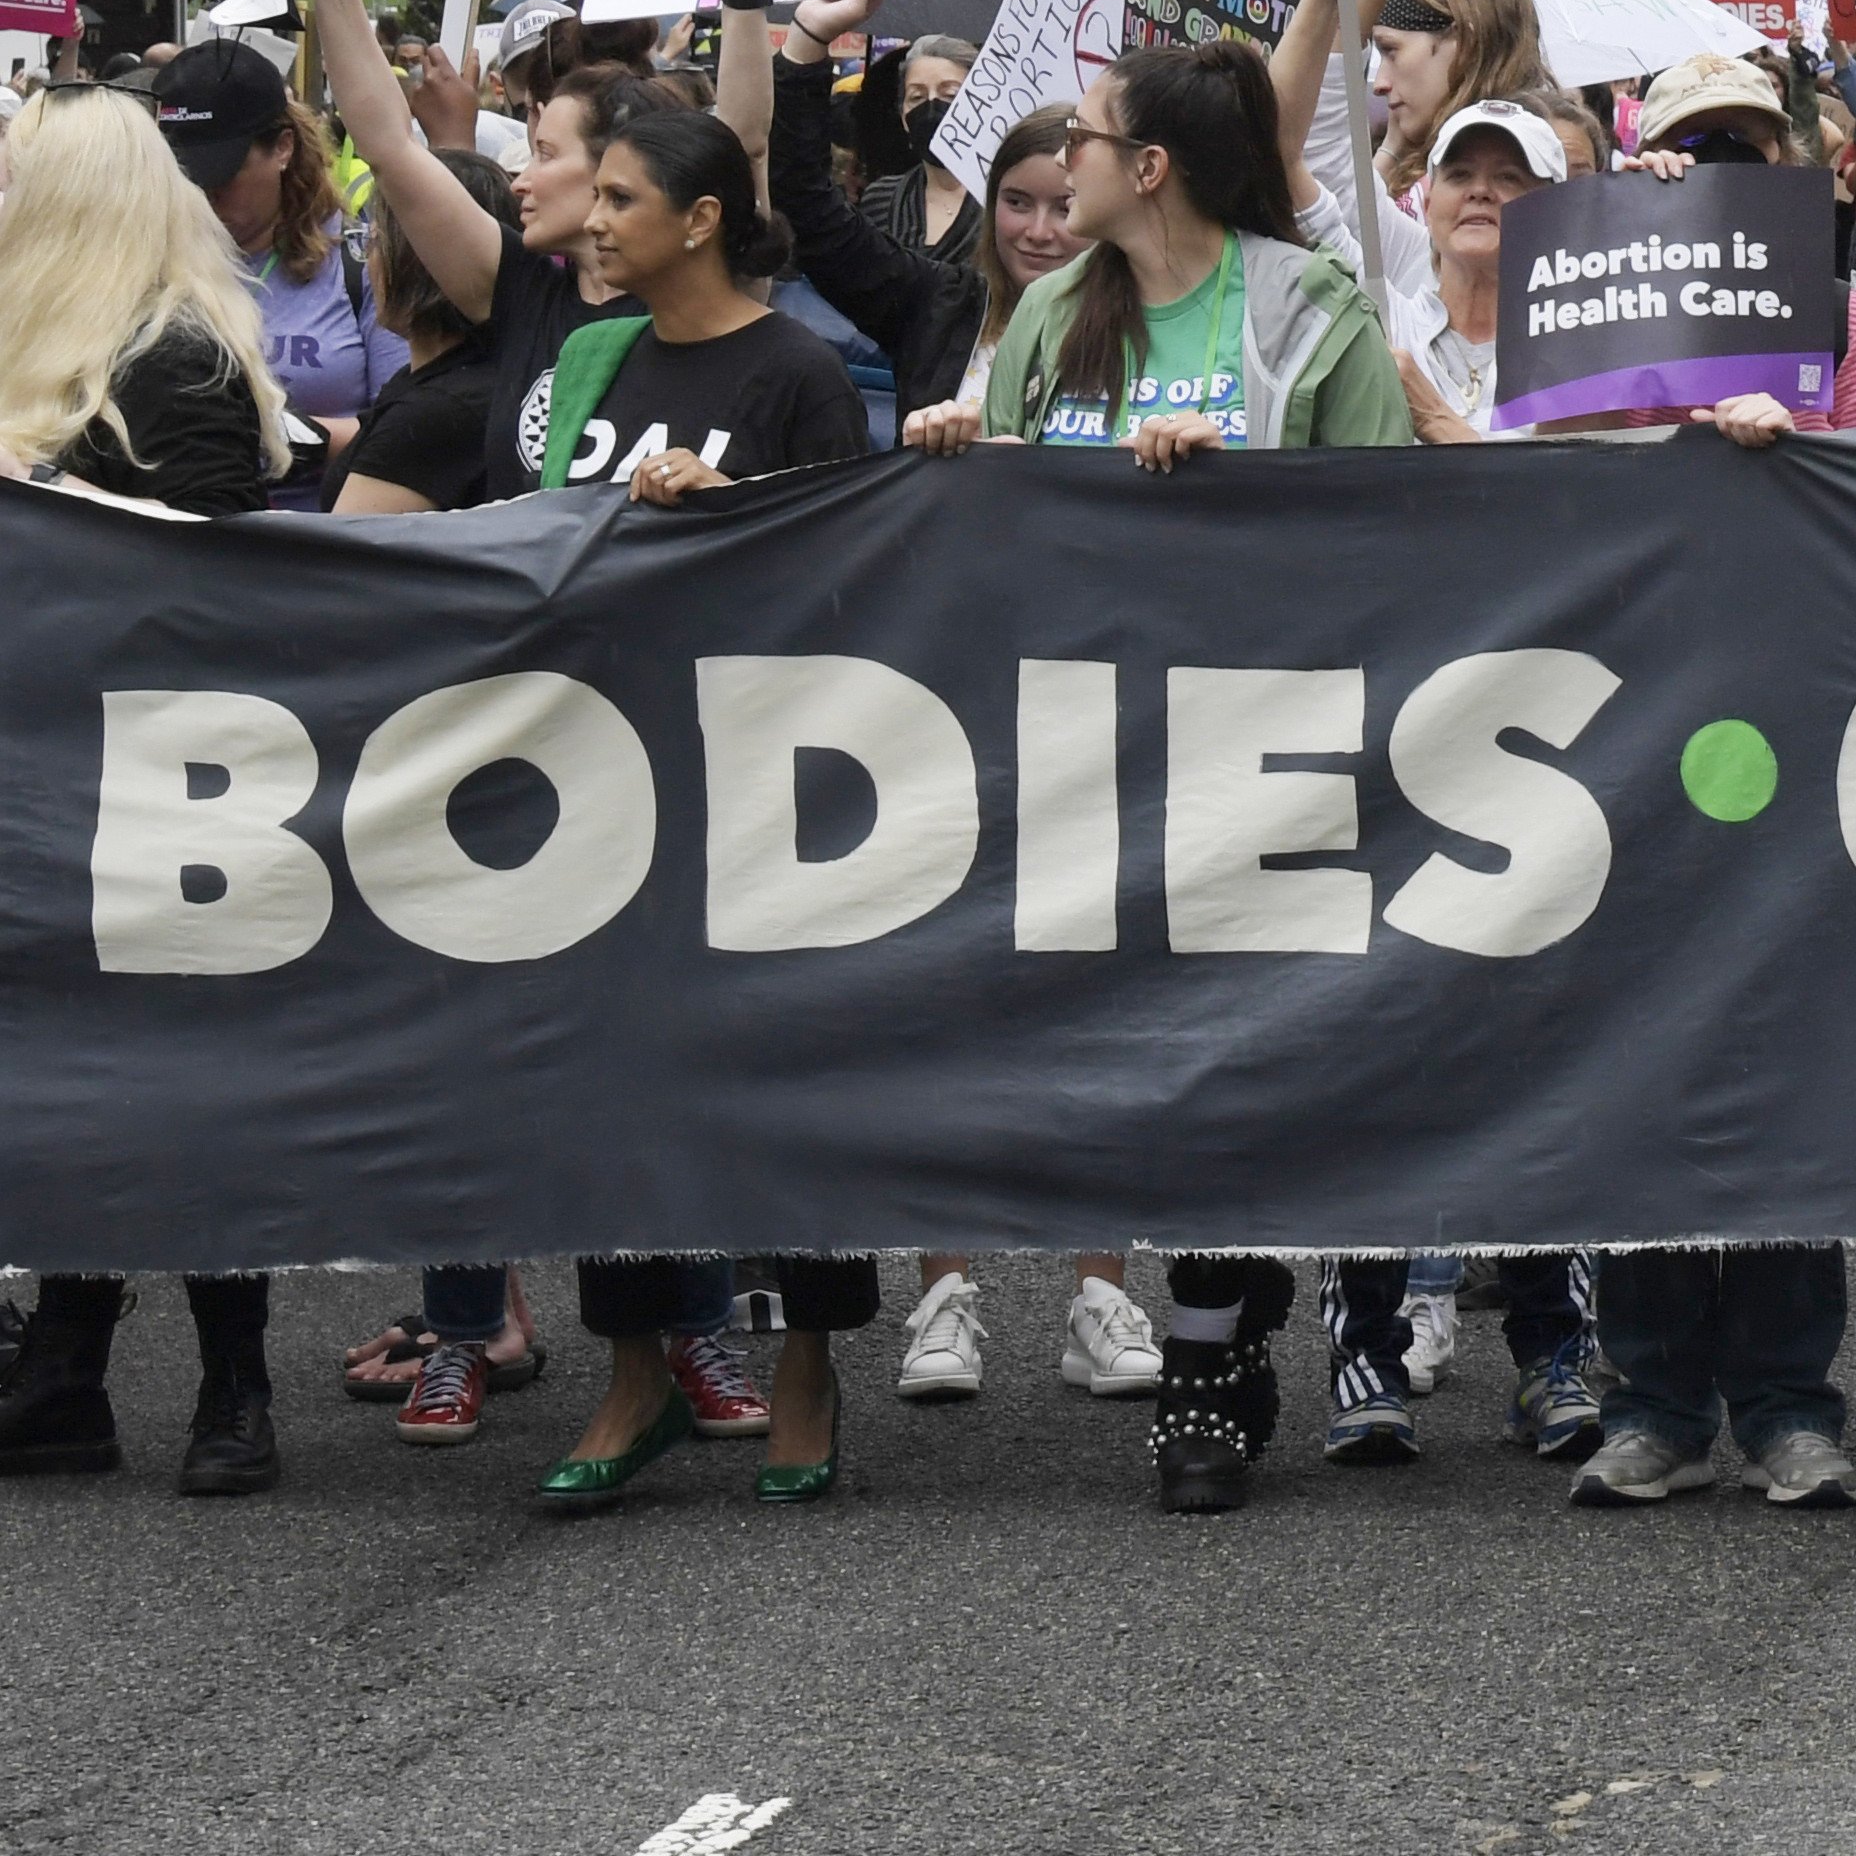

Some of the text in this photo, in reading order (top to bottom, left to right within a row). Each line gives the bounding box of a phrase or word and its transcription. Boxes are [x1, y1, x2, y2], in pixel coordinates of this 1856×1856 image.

[1718, 2, 1799, 31] DIES.
[940, 22, 1022, 161] REASONS
[1526, 230, 1768, 292] Abortion is
[1528, 281, 1793, 337] Health Care.
[1044, 409, 1106, 437] OUR
[90, 647, 1623, 978] BODIES
